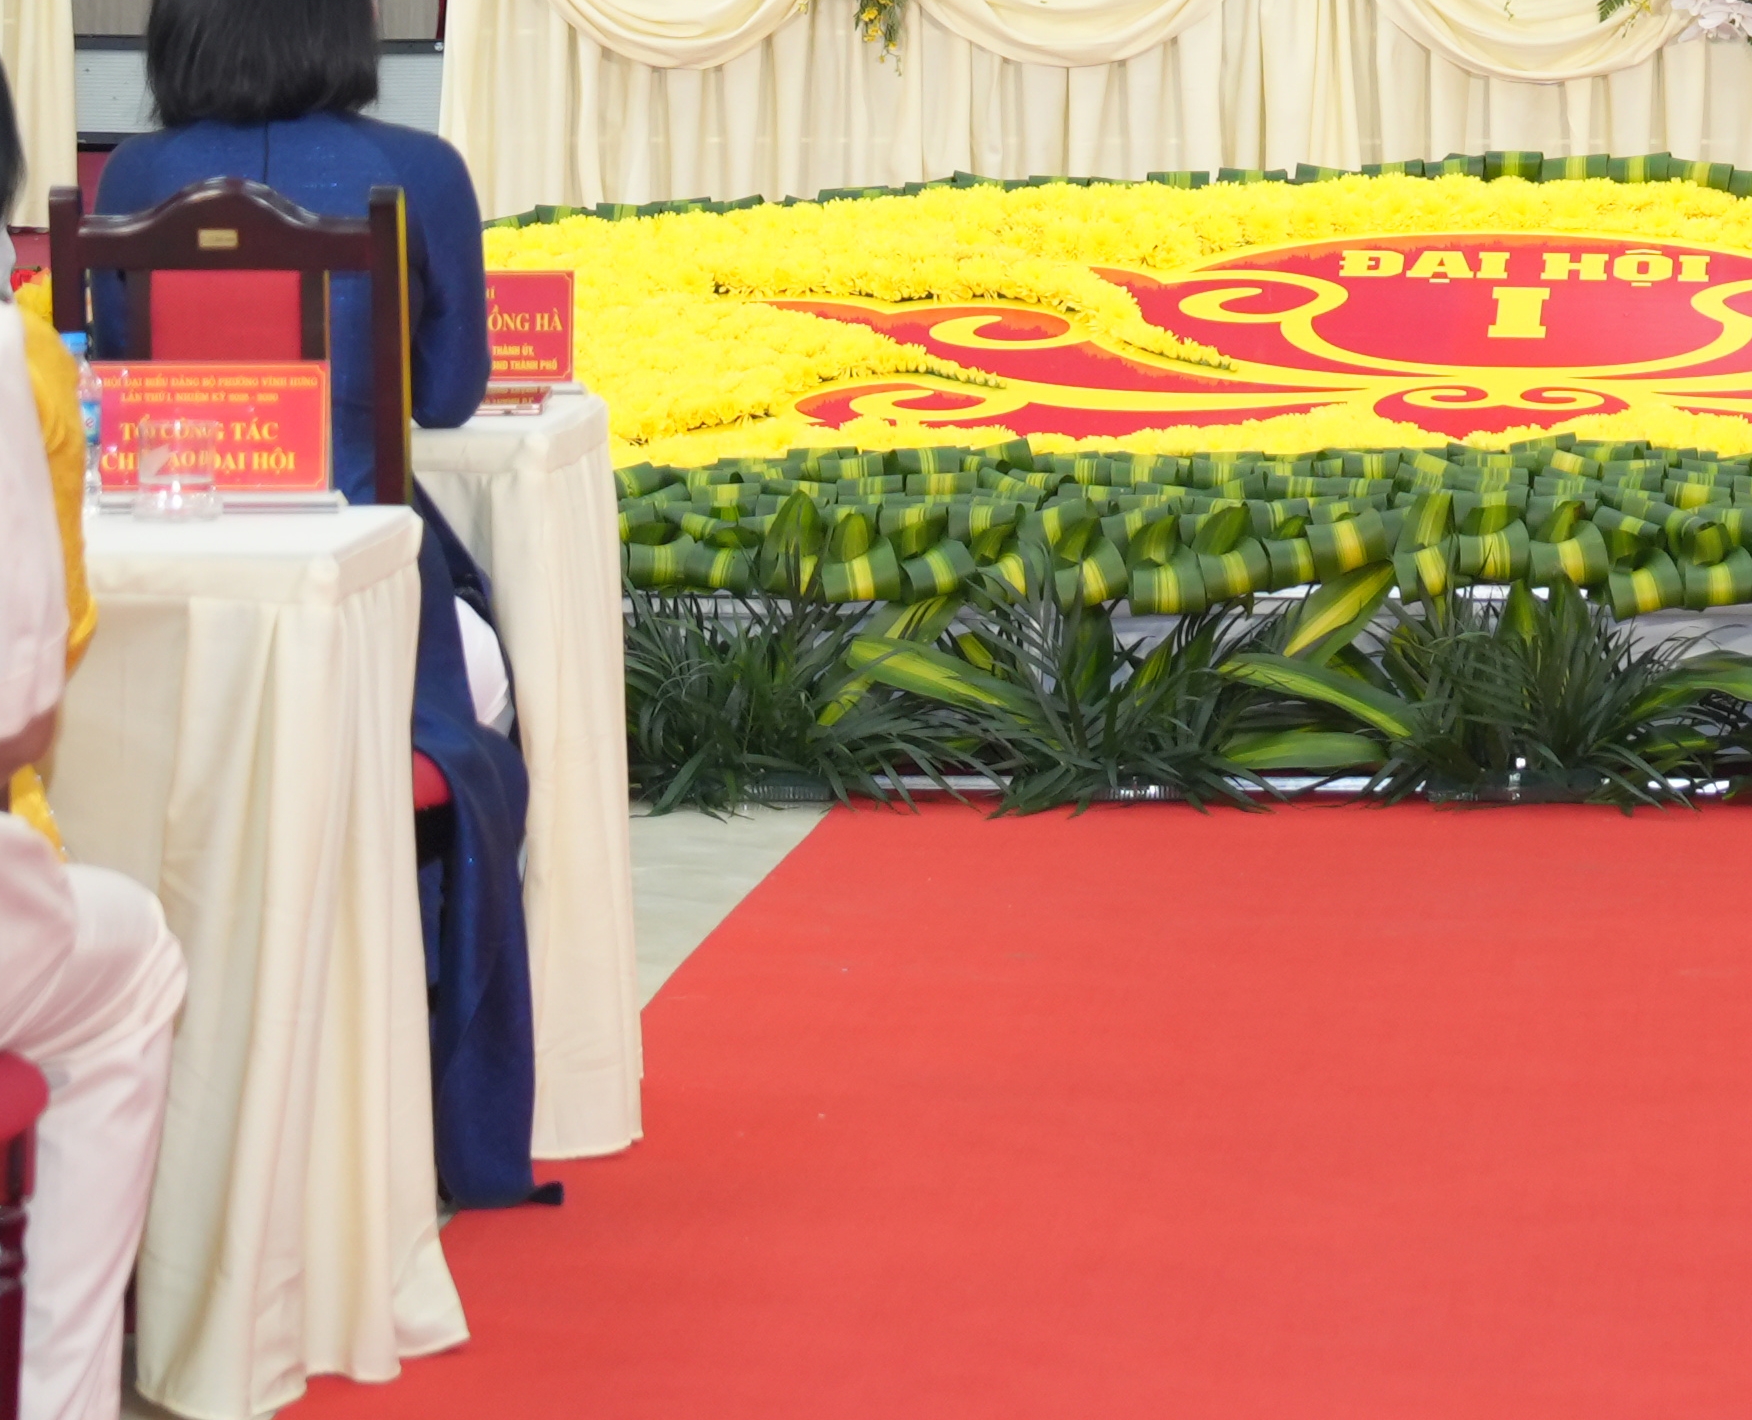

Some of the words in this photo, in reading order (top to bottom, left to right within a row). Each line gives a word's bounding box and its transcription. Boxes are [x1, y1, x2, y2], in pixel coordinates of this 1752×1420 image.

[1338, 249, 1511, 284] ĐẠI
[1542, 248, 1711, 287] HỘI
[535, 307, 563, 331] HÀ
[1487, 287, 1549, 339] I
[230, 417, 279, 441] TÁC
[251, 447, 296, 474] HỘI
